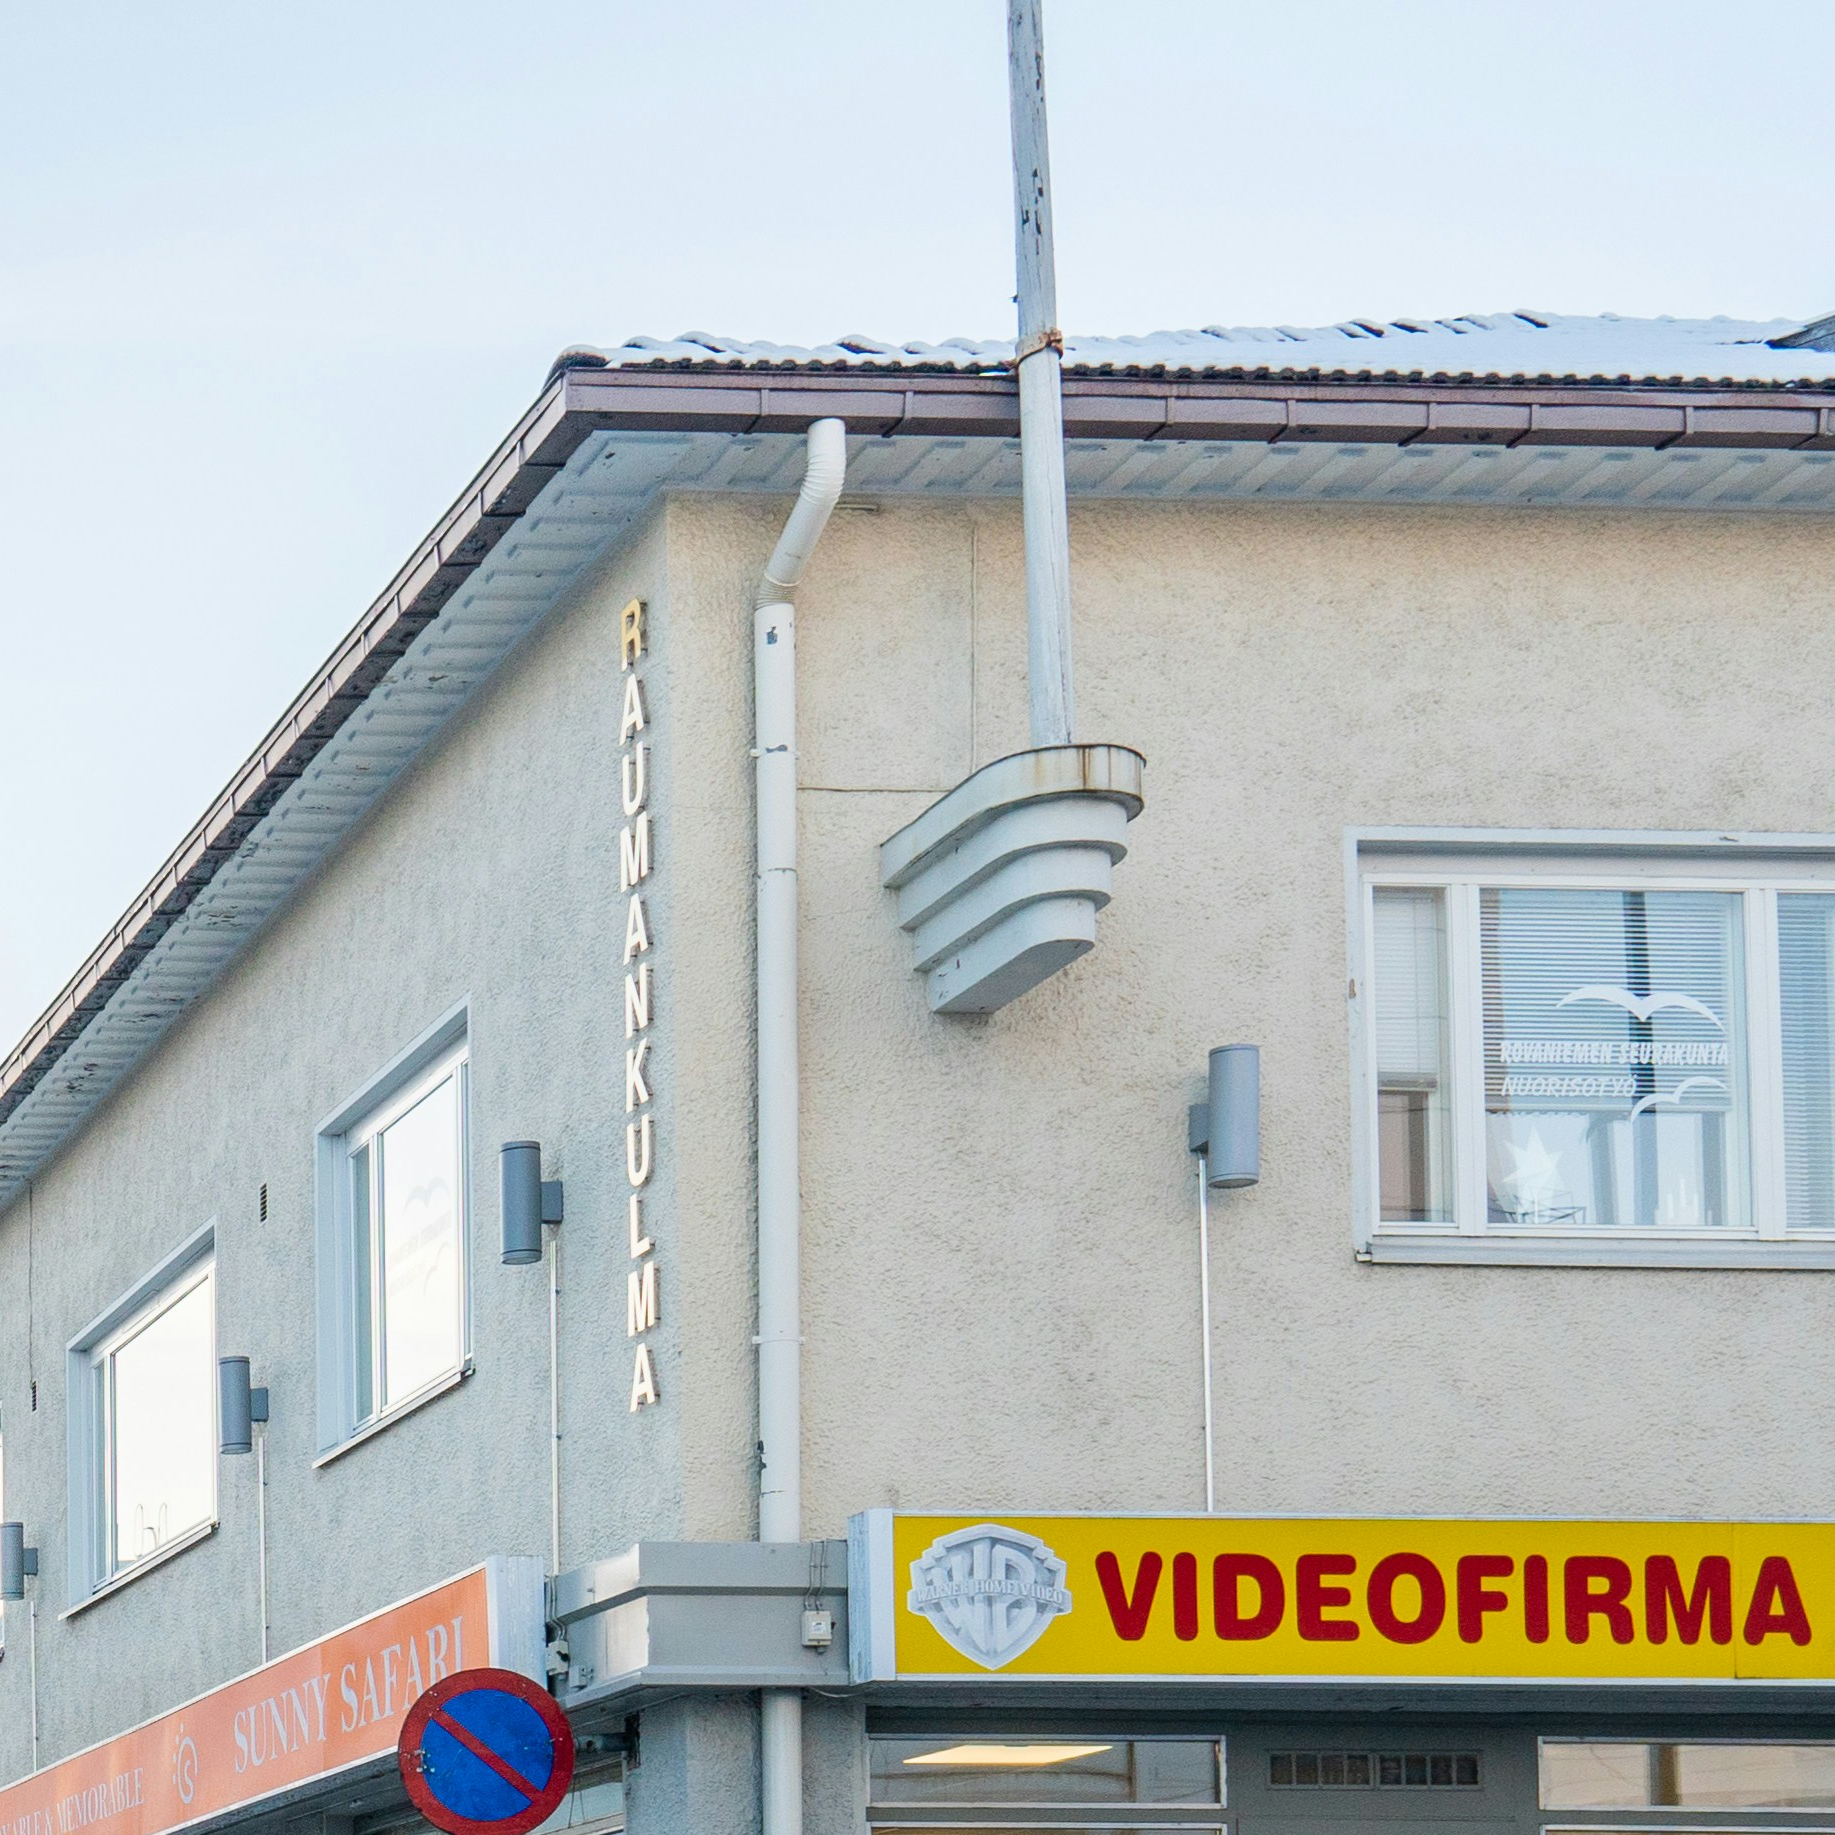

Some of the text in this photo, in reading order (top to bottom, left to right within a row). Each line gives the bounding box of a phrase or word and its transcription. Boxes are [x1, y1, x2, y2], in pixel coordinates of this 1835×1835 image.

[619, 597, 656, 1413] RAUMANKULMA
[1499, 1041, 1729, 1066] ROVANIEMEN SEURAKUNTA
[1501, 1074, 1638, 1098] NUORISOTYÖ
[917, 1579, 1063, 1604] WARNER HOME VIDEO
[1095, 1551, 1812, 1646] VIDEOFIRMA
[234, 1615, 463, 1775] SUNNY SAFARI
